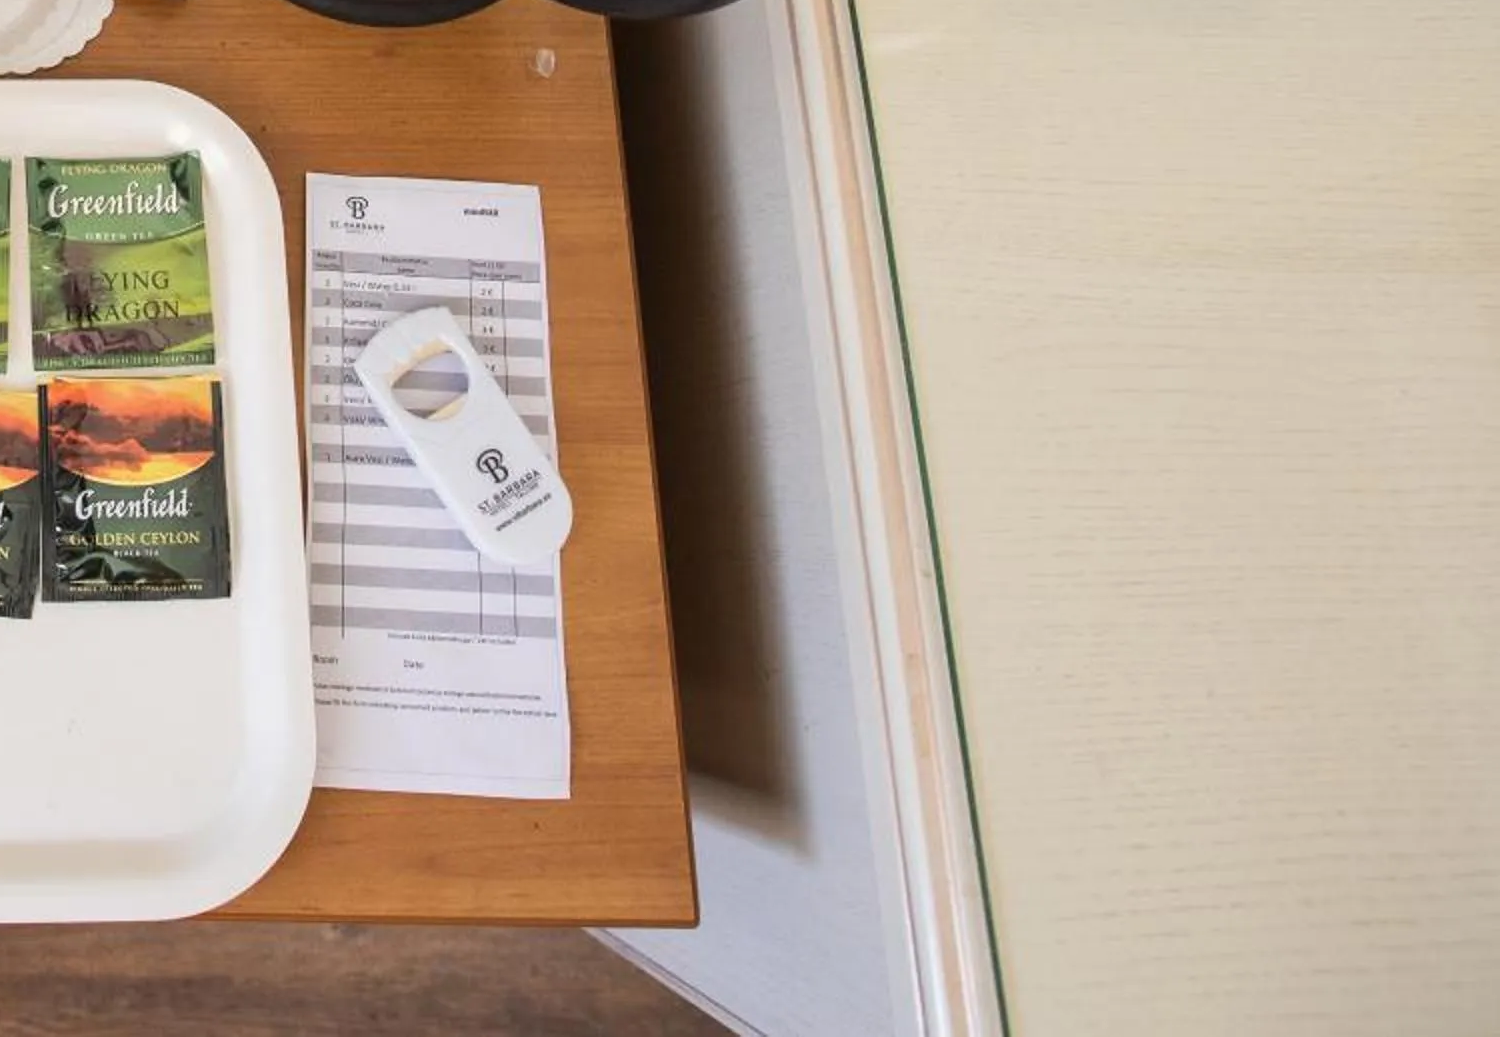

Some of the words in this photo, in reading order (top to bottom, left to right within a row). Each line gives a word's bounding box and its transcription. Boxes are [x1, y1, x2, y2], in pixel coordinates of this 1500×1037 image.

[109, 162, 168, 176] DRAGON
[48, 180, 181, 219] Greenfield
[63, 299, 181, 323] DRAGON
[475, 448, 509, 483] B
[75, 488, 191, 520] Greenfield
[68, 533, 137, 547] GOLDEN
[139, 529, 201, 545] CEYLON
